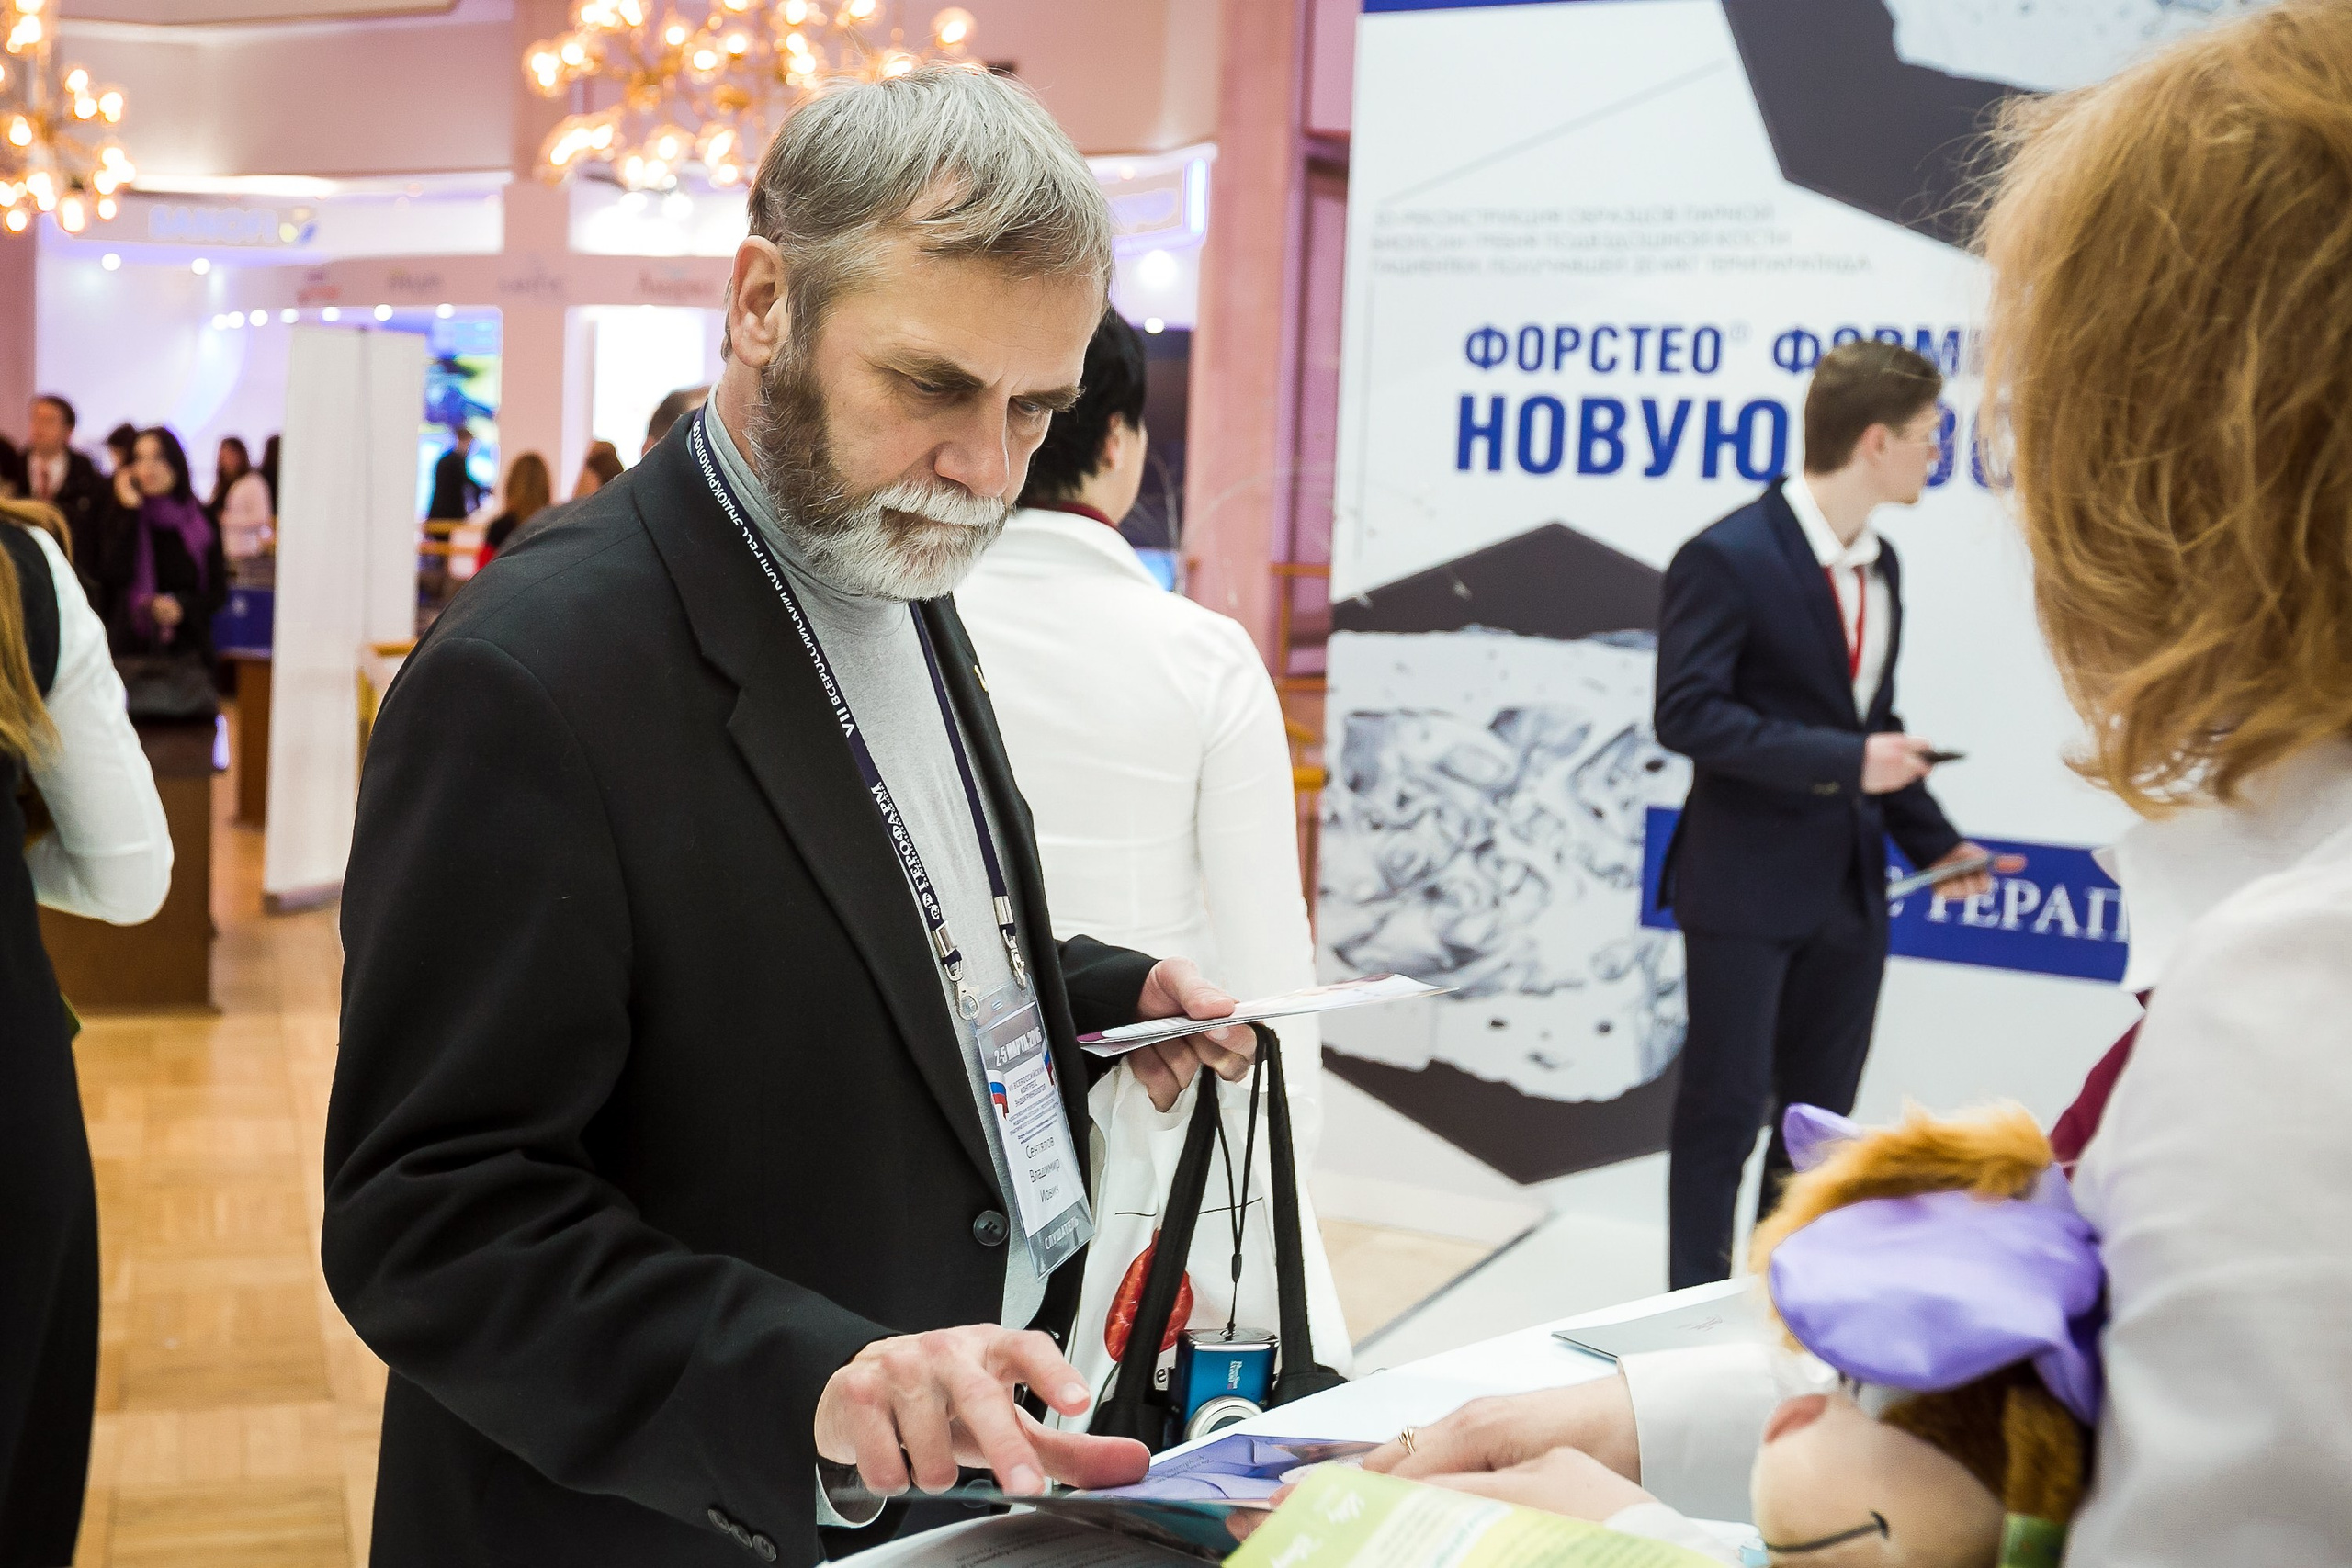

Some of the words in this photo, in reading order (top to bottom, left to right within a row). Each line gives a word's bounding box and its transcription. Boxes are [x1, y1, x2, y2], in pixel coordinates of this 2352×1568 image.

[1465, 322, 1724, 376] ФОРСТЕО
[1456, 392, 1789, 482] НОВУЮ
[836, 706, 855, 739] VII
[870, 782, 926, 892] ГЕРОФАРМ
